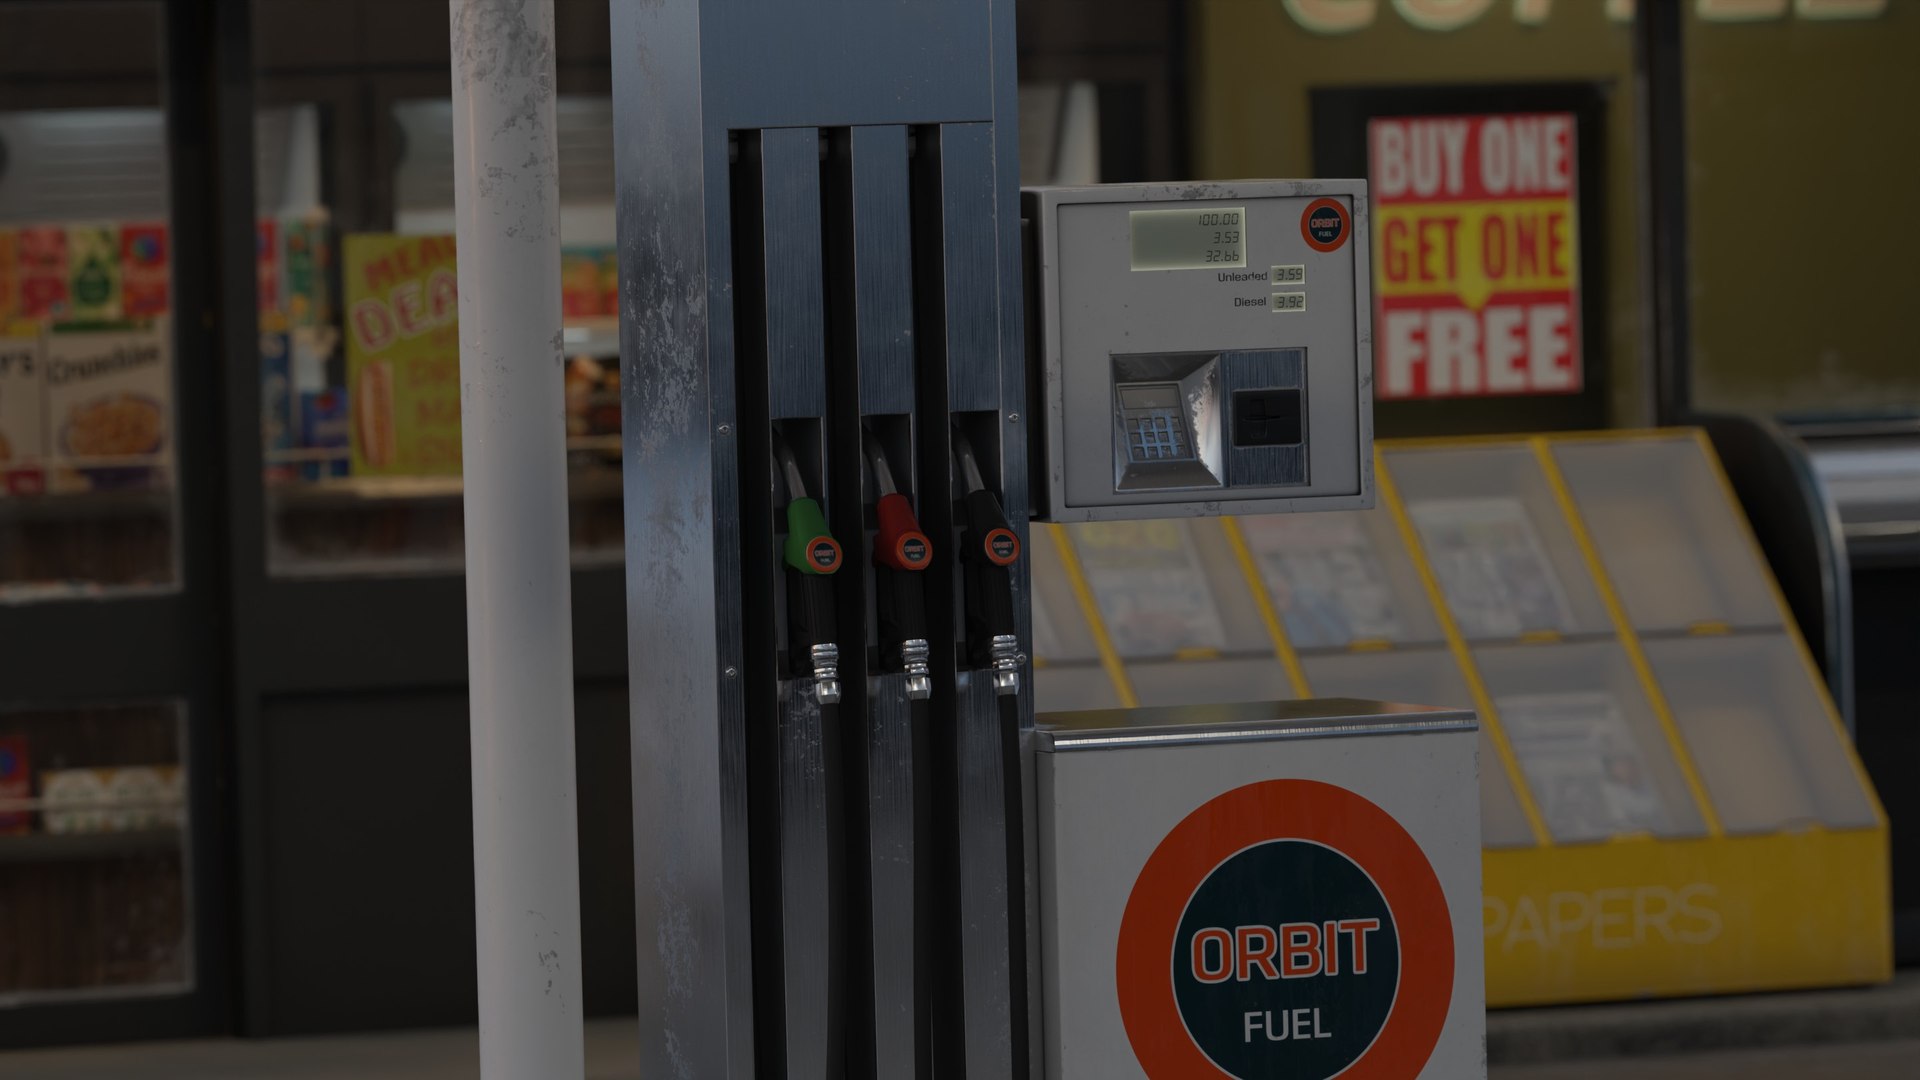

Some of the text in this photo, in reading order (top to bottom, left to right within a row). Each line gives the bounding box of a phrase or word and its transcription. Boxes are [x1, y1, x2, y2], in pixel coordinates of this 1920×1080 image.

[1377, 114, 1568, 197] BUY ONE
[1198, 213, 1240, 226] 100.00
[1311, 218, 1340, 228] ORBIT
[1213, 231, 1240, 244] 3.53
[1384, 213, 1566, 283] GET ONE
[1217, 272, 1268, 283] Unleaded
[1277, 268, 1303, 281] 3.59
[1234, 297, 1267, 308] Diesel
[1277, 296, 1304, 309] 3.92
[1384, 304, 1572, 396] FREE
[1190, 917, 1381, 985] ORBIT
[1243, 1007, 1332, 1044] FUEL
